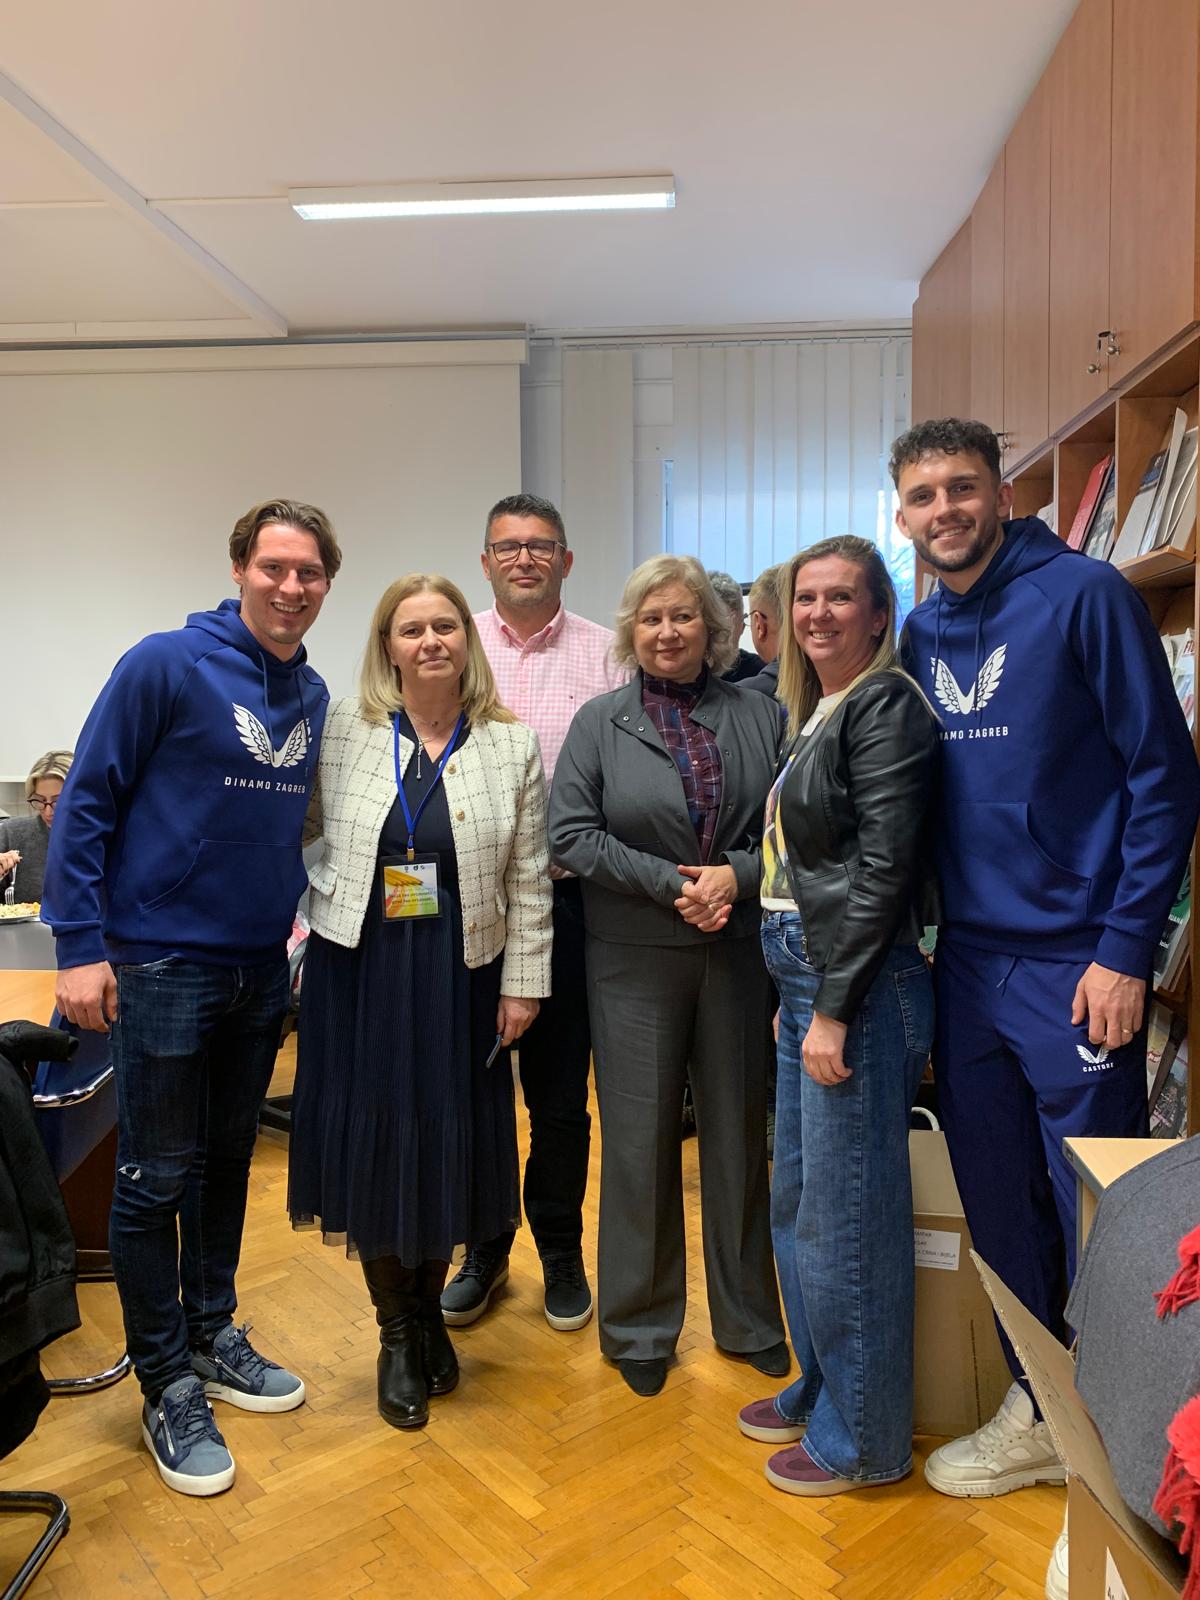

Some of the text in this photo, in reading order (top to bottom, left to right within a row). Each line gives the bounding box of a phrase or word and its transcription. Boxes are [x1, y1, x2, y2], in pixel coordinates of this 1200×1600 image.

[968, 726, 1009, 739] ZAGREB
[224, 776, 306, 794] DINAMO ZAGREB
